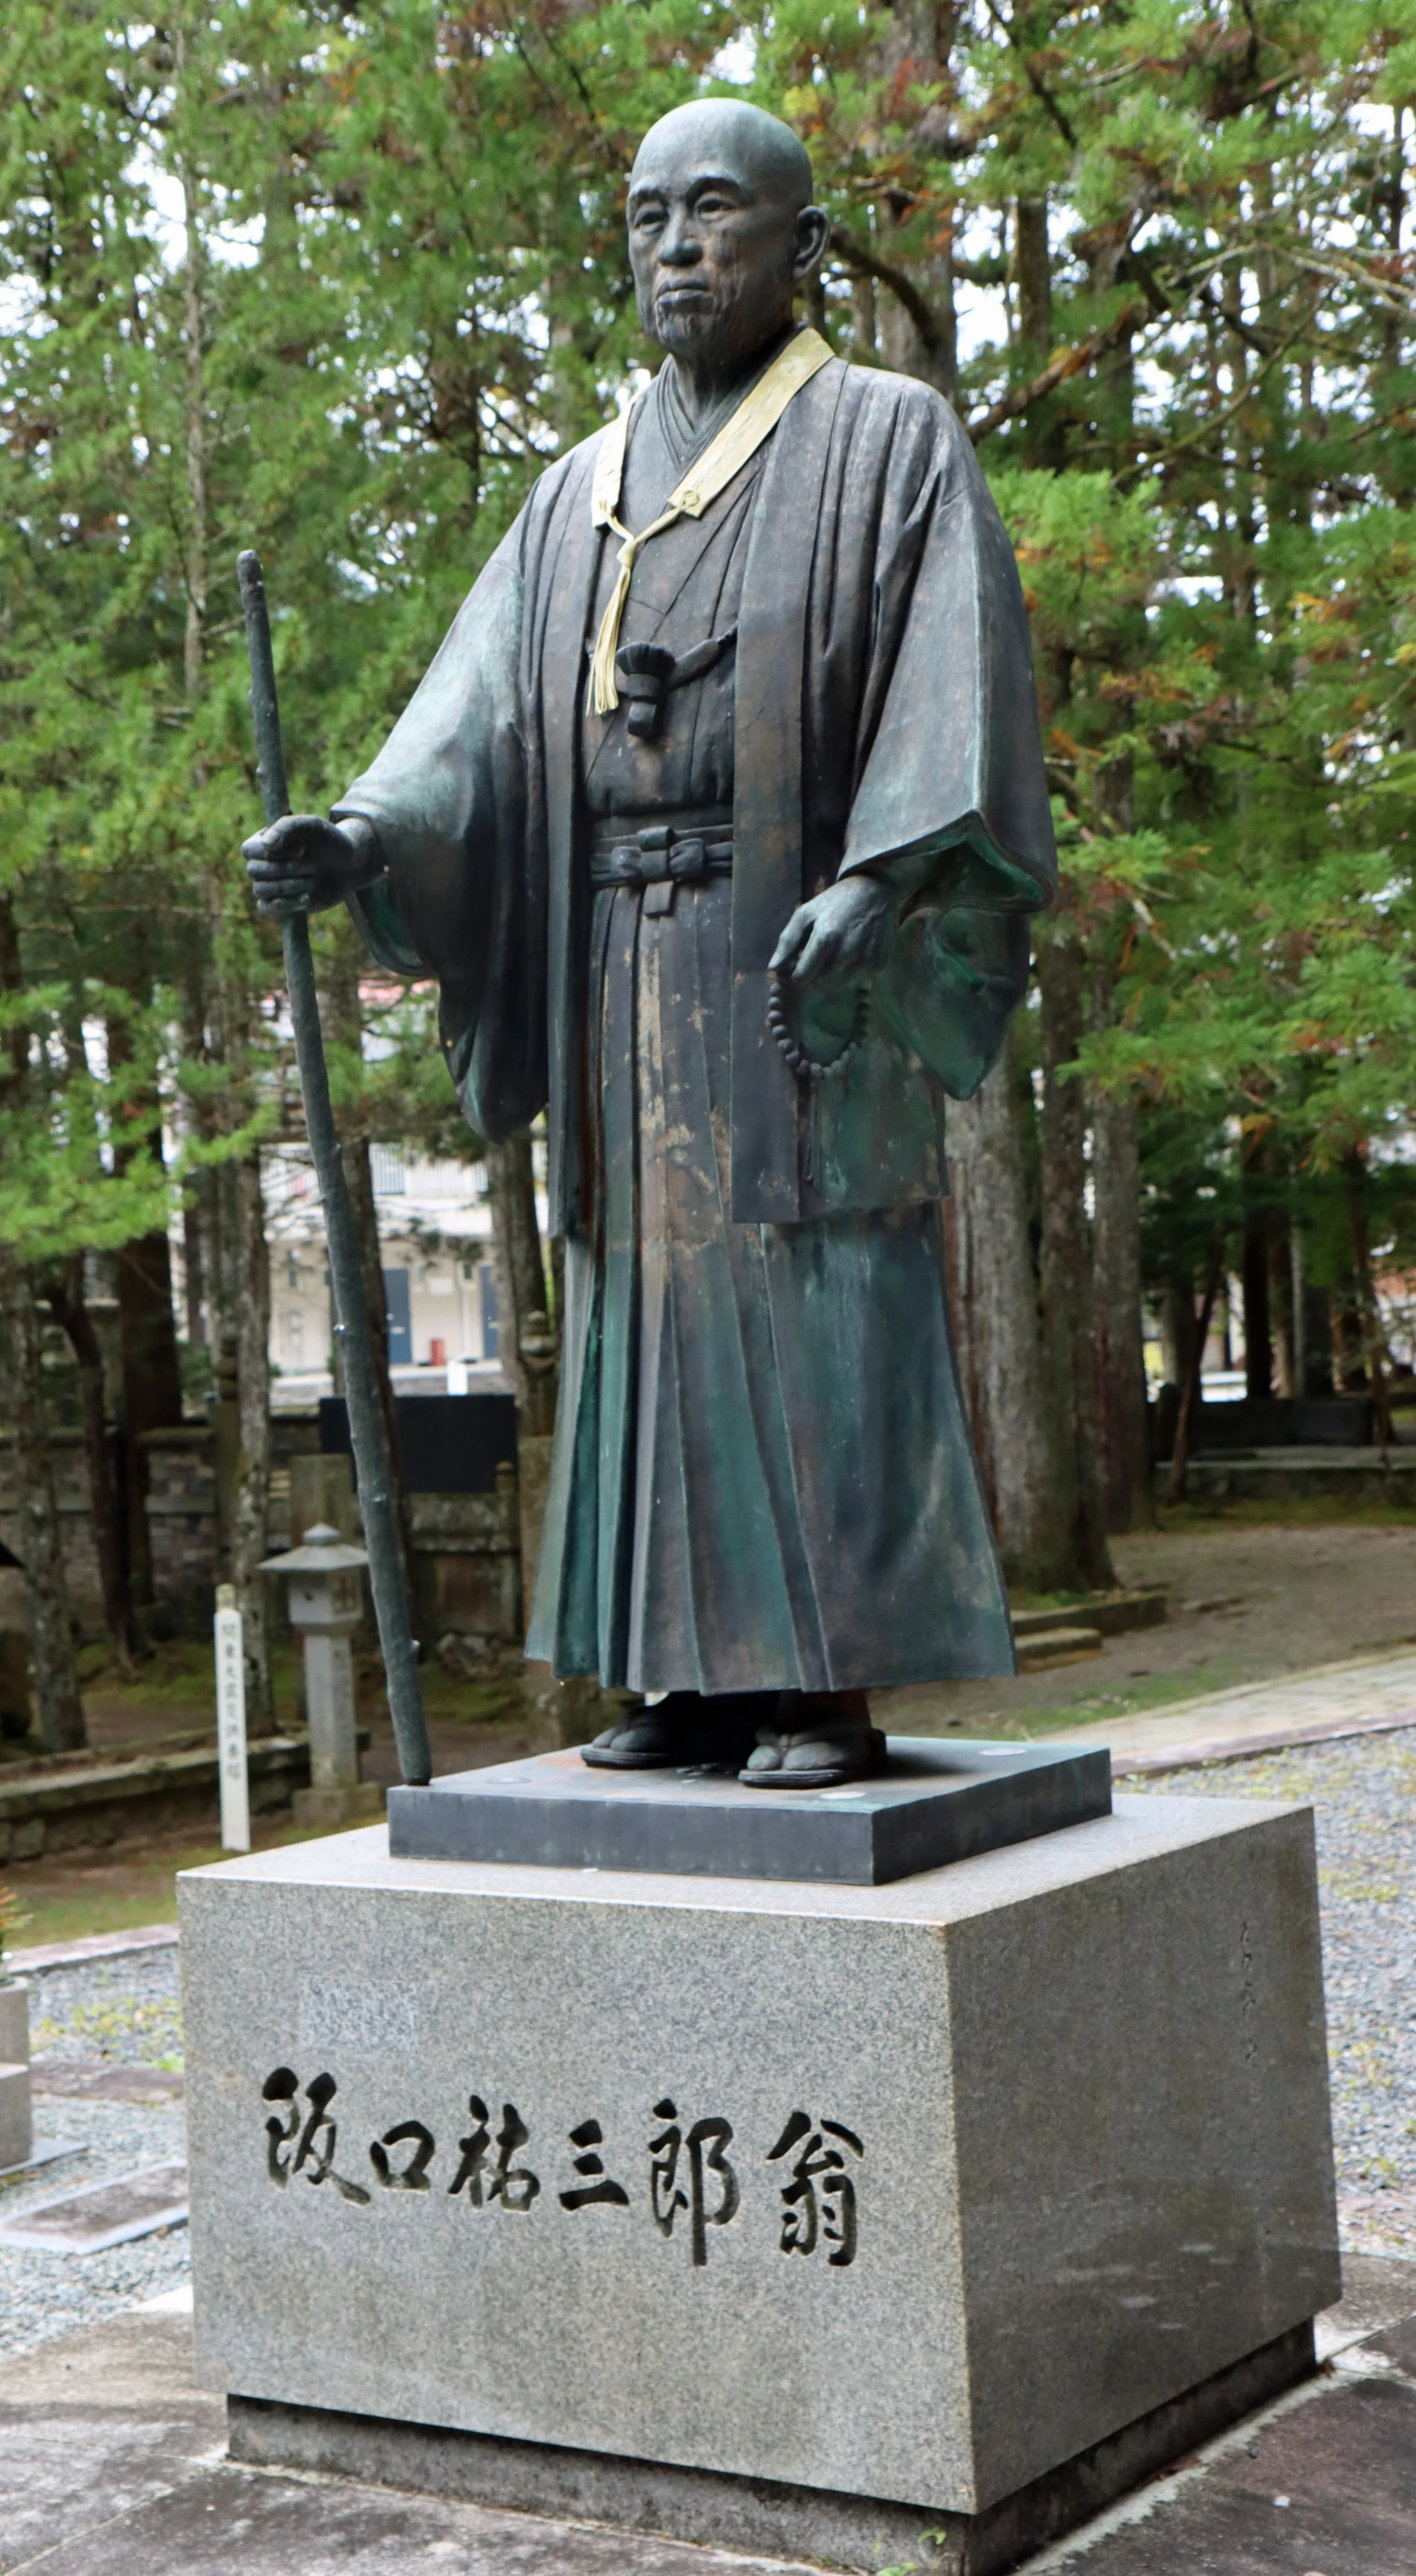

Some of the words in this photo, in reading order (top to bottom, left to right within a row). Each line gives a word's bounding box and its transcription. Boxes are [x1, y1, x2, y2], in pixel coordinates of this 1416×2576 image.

[262, 2066, 865, 2265] 阪口祐三郎翁
